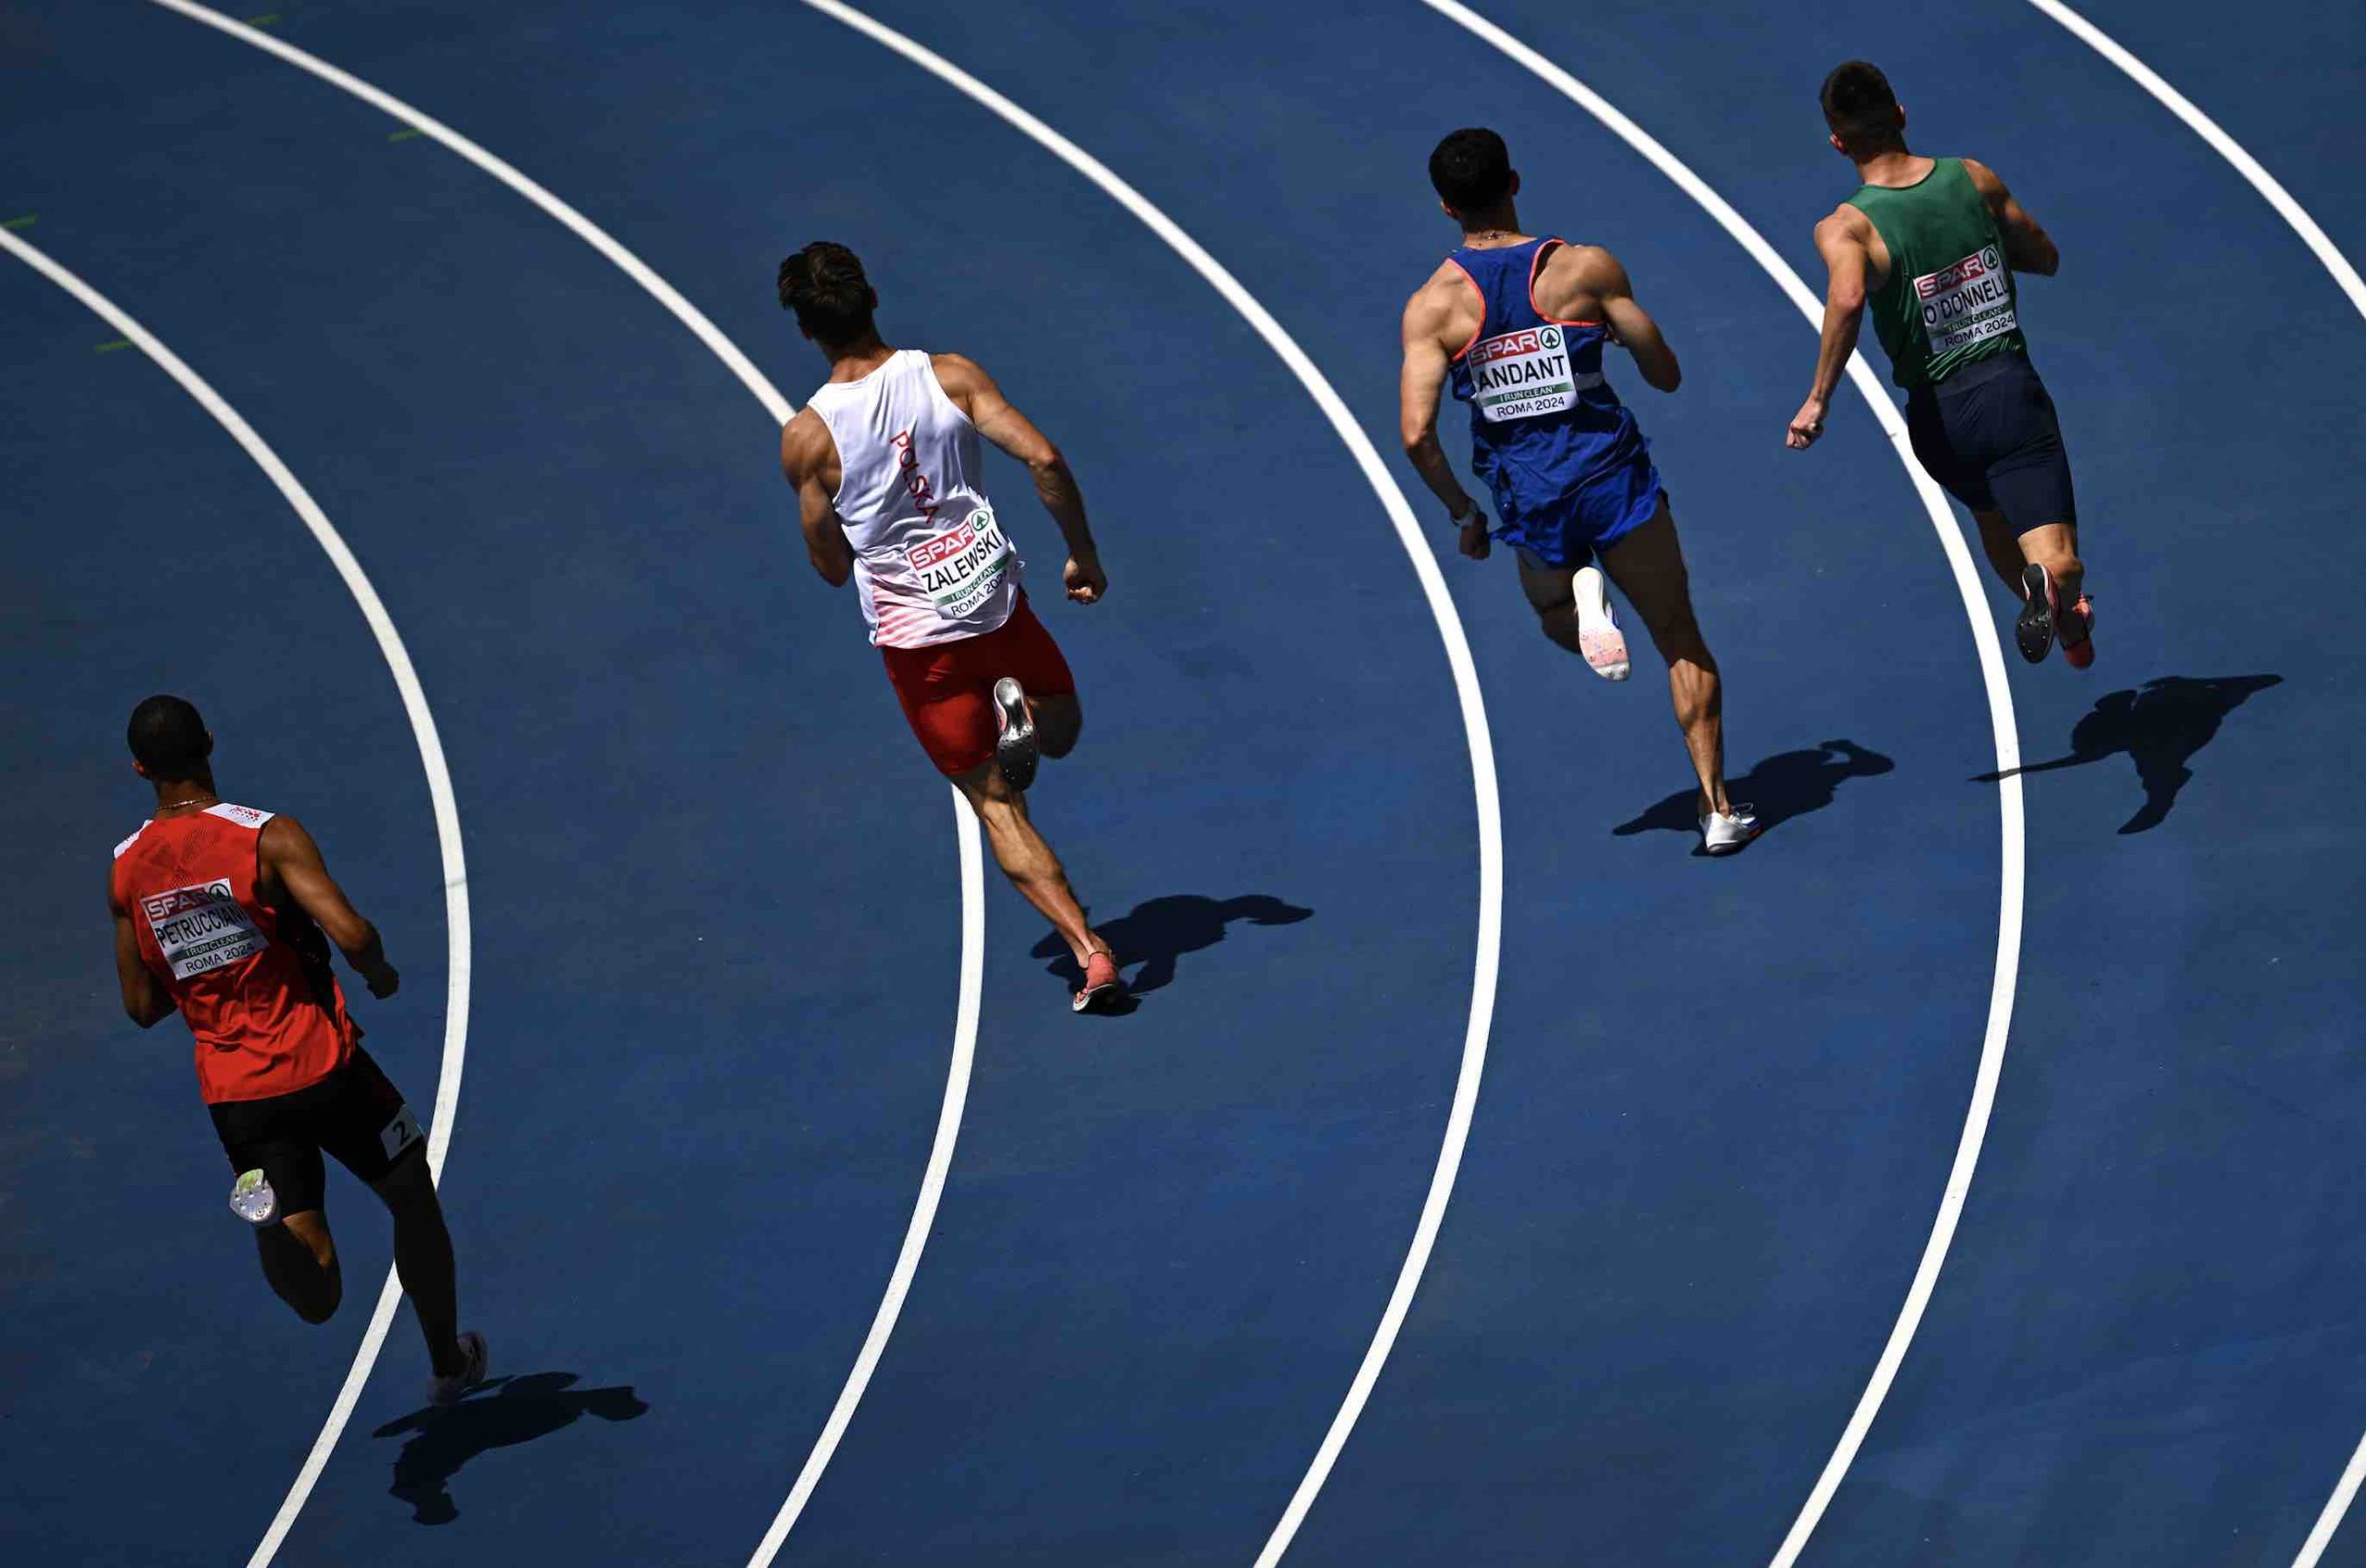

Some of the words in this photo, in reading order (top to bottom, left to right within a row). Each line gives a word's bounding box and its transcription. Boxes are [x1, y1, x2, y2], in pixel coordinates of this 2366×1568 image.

[1919, 258, 1982, 296] SPAR
[1923, 276, 2009, 323] O'DONNELL
[1945, 327, 1983, 346] ROMA
[1984, 315, 2014, 334] 2024
[1471, 334, 1538, 364] SPAR
[1479, 355, 1565, 392] ANDANT
[1496, 401, 1534, 417] ROMA
[1535, 396, 1565, 410] 2024
[1504, 390, 1524, 401] RUN
[1524, 386, 1554, 397] CLEAN
[911, 524, 974, 567] SPAR
[921, 529, 1002, 592] ZALEWSKI
[951, 590, 985, 615] ROMA
[186, 954, 223, 972] ROMA
[224, 942, 254, 959] 2024
[190, 943, 210, 955] RUN
[392, 1121, 411, 1147] 2
